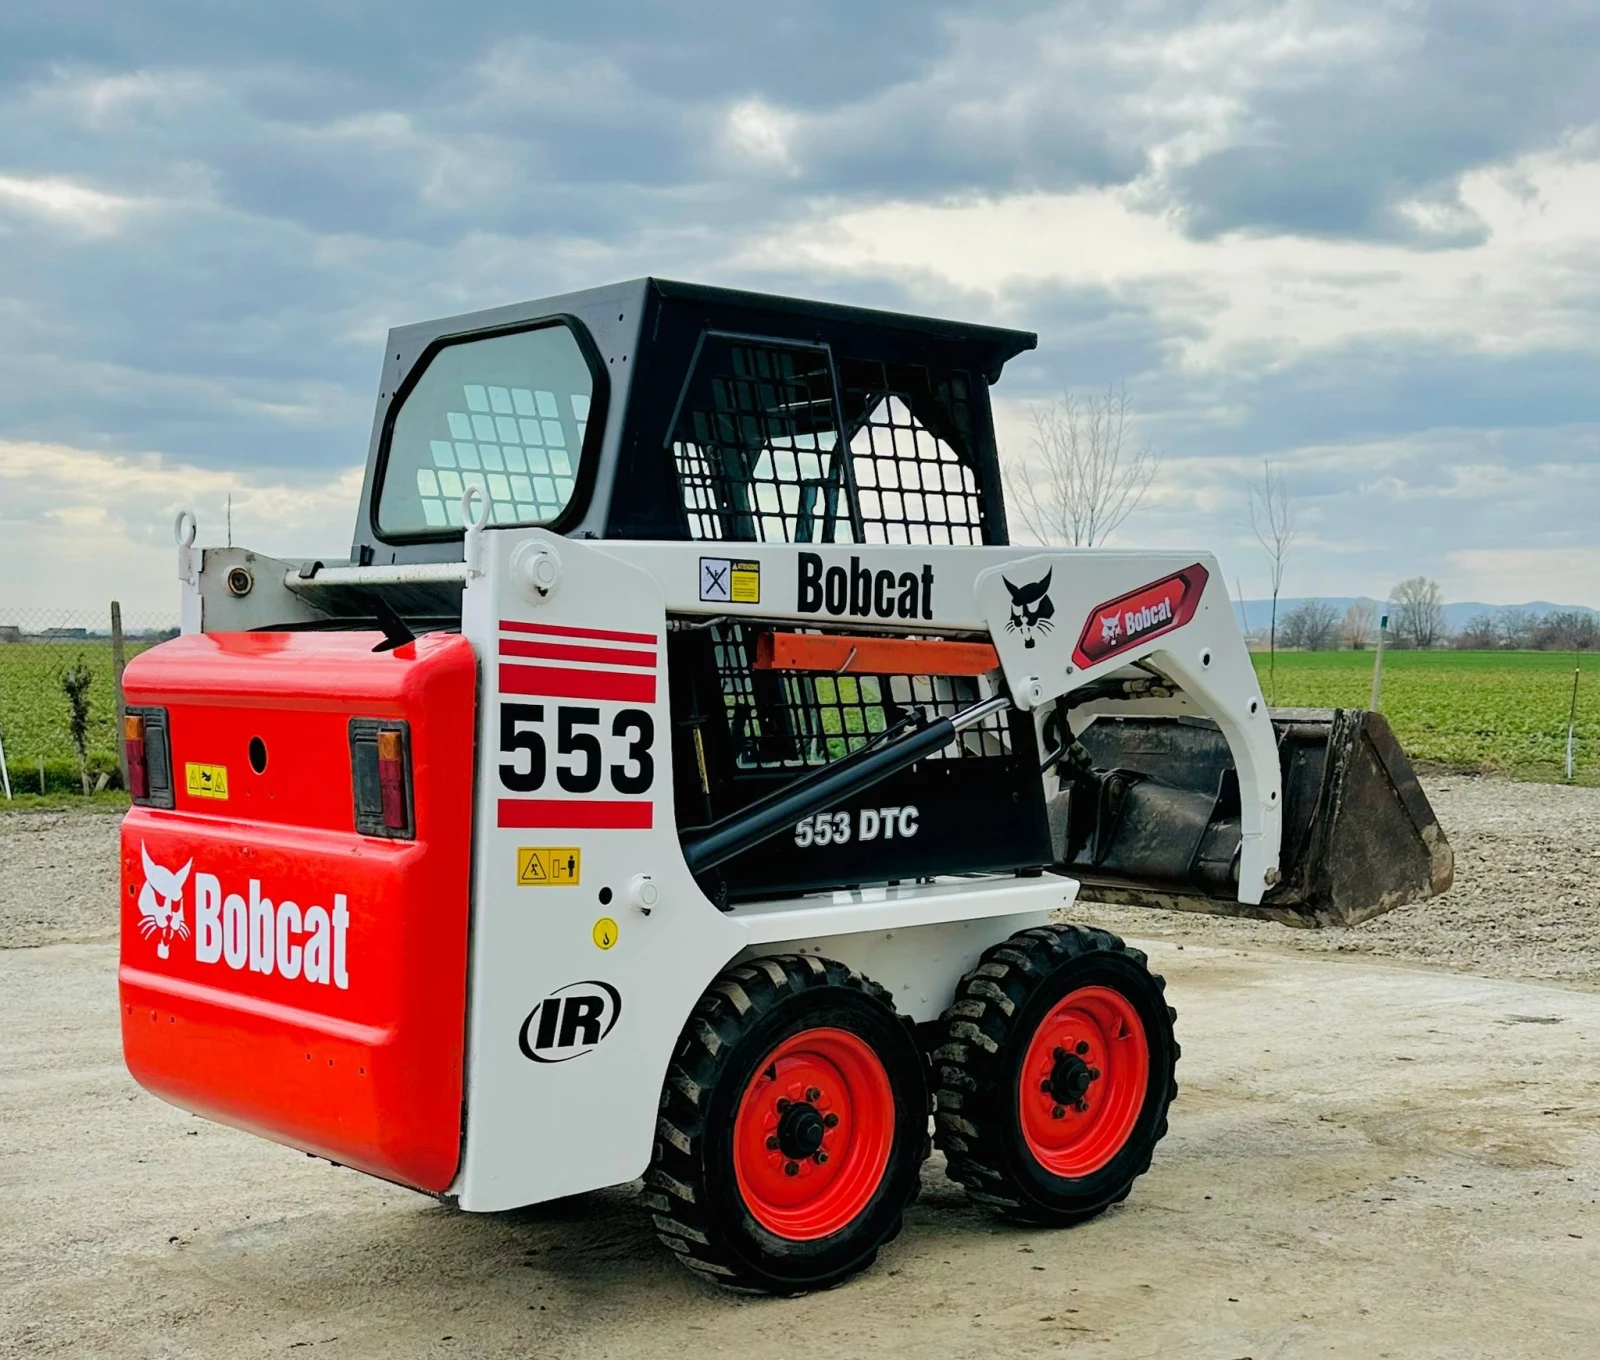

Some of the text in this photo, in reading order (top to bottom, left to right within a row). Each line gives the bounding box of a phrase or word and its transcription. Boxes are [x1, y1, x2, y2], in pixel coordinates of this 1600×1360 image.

[797, 551, 934, 620] Bobcat
[1124, 596, 1172, 636] Bobcat
[498, 702, 655, 795] 553
[794, 805, 919, 848] 553 DTC
[195, 872, 349, 990] Bobcat
[535, 995, 605, 1049] IR
